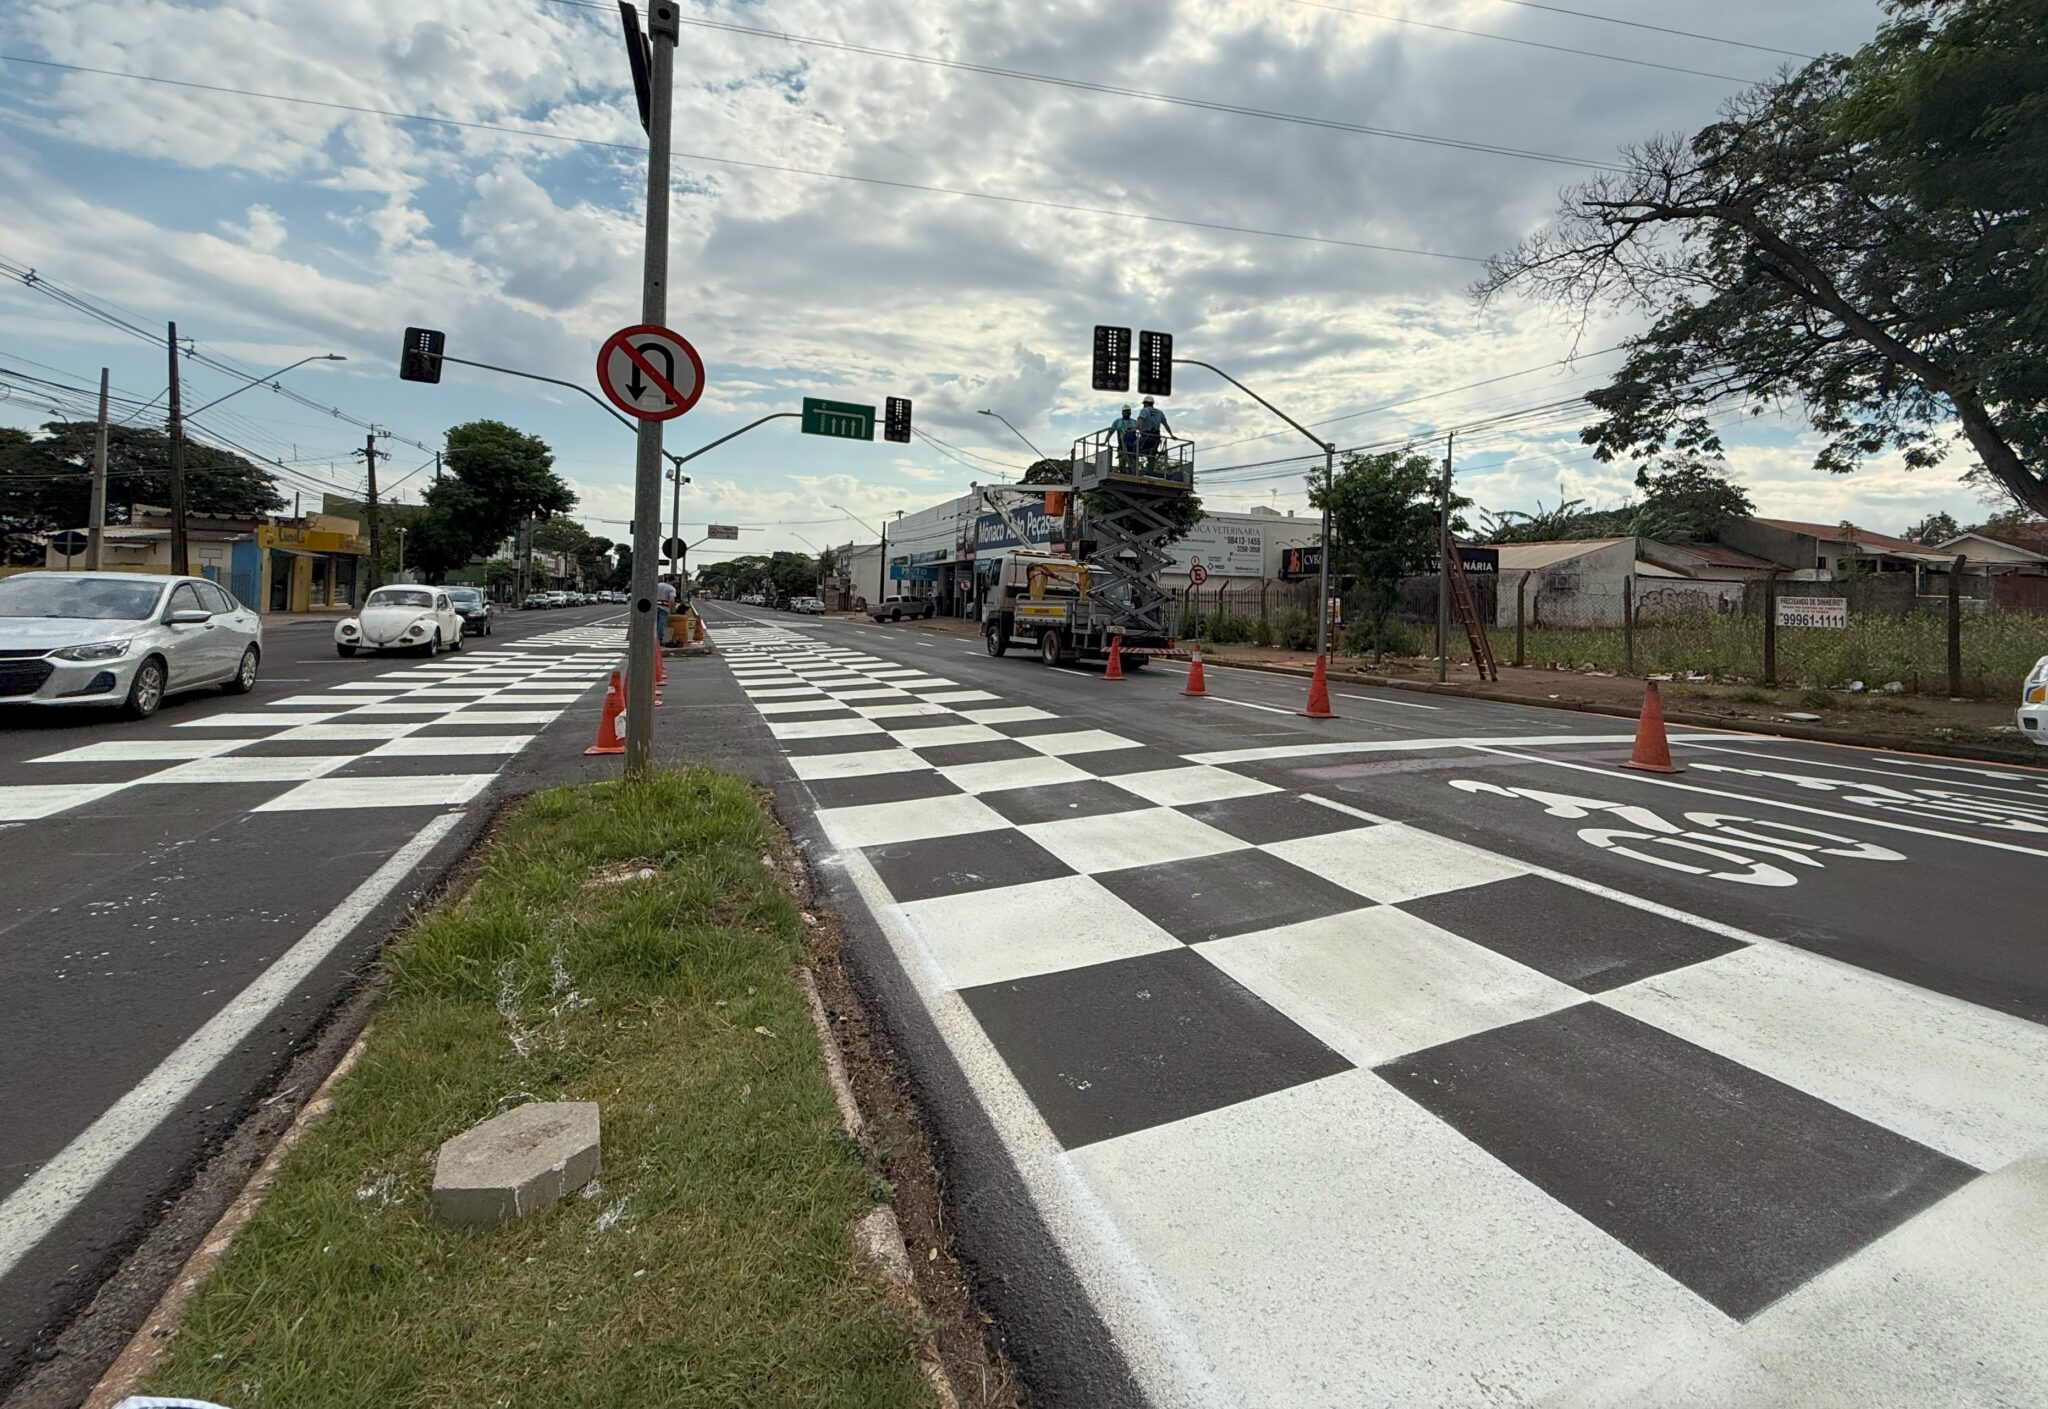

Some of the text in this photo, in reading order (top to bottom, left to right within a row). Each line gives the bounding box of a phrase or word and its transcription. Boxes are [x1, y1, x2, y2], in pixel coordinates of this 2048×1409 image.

[978, 521, 1004, 544] Mônaco
[1026, 511, 1050, 542] Peças
[1783, 613, 1844, 627] 99961-1111
